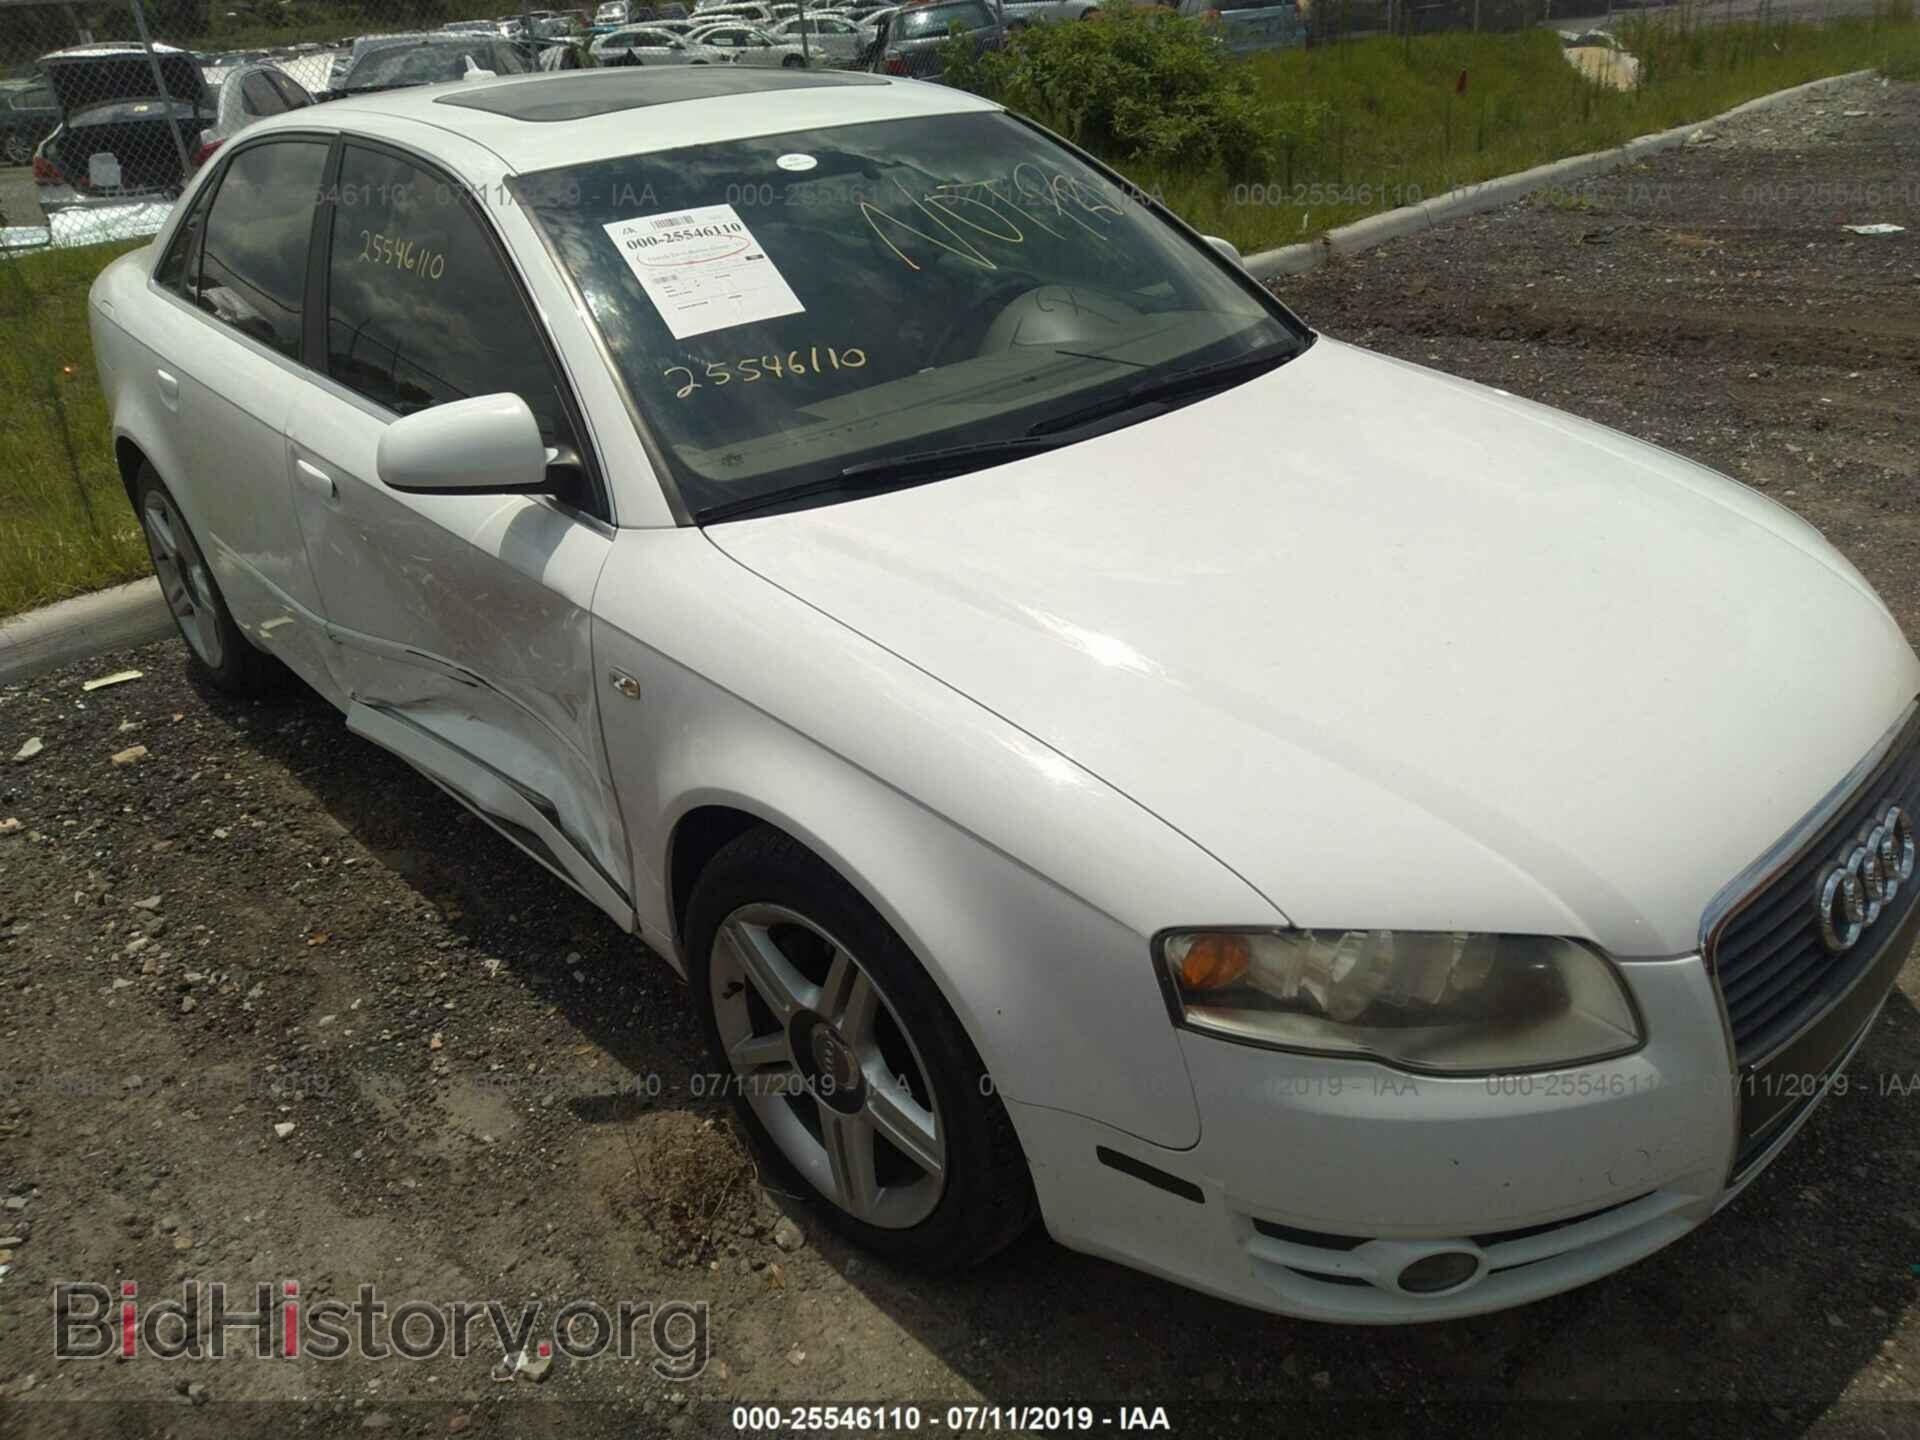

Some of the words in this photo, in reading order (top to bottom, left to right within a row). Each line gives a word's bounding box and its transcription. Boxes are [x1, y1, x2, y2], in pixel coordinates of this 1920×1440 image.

[360, 229, 444, 279] 25546110
[625, 222, 742, 250] 000-25546110
[664, 346, 867, 399] 25546110
